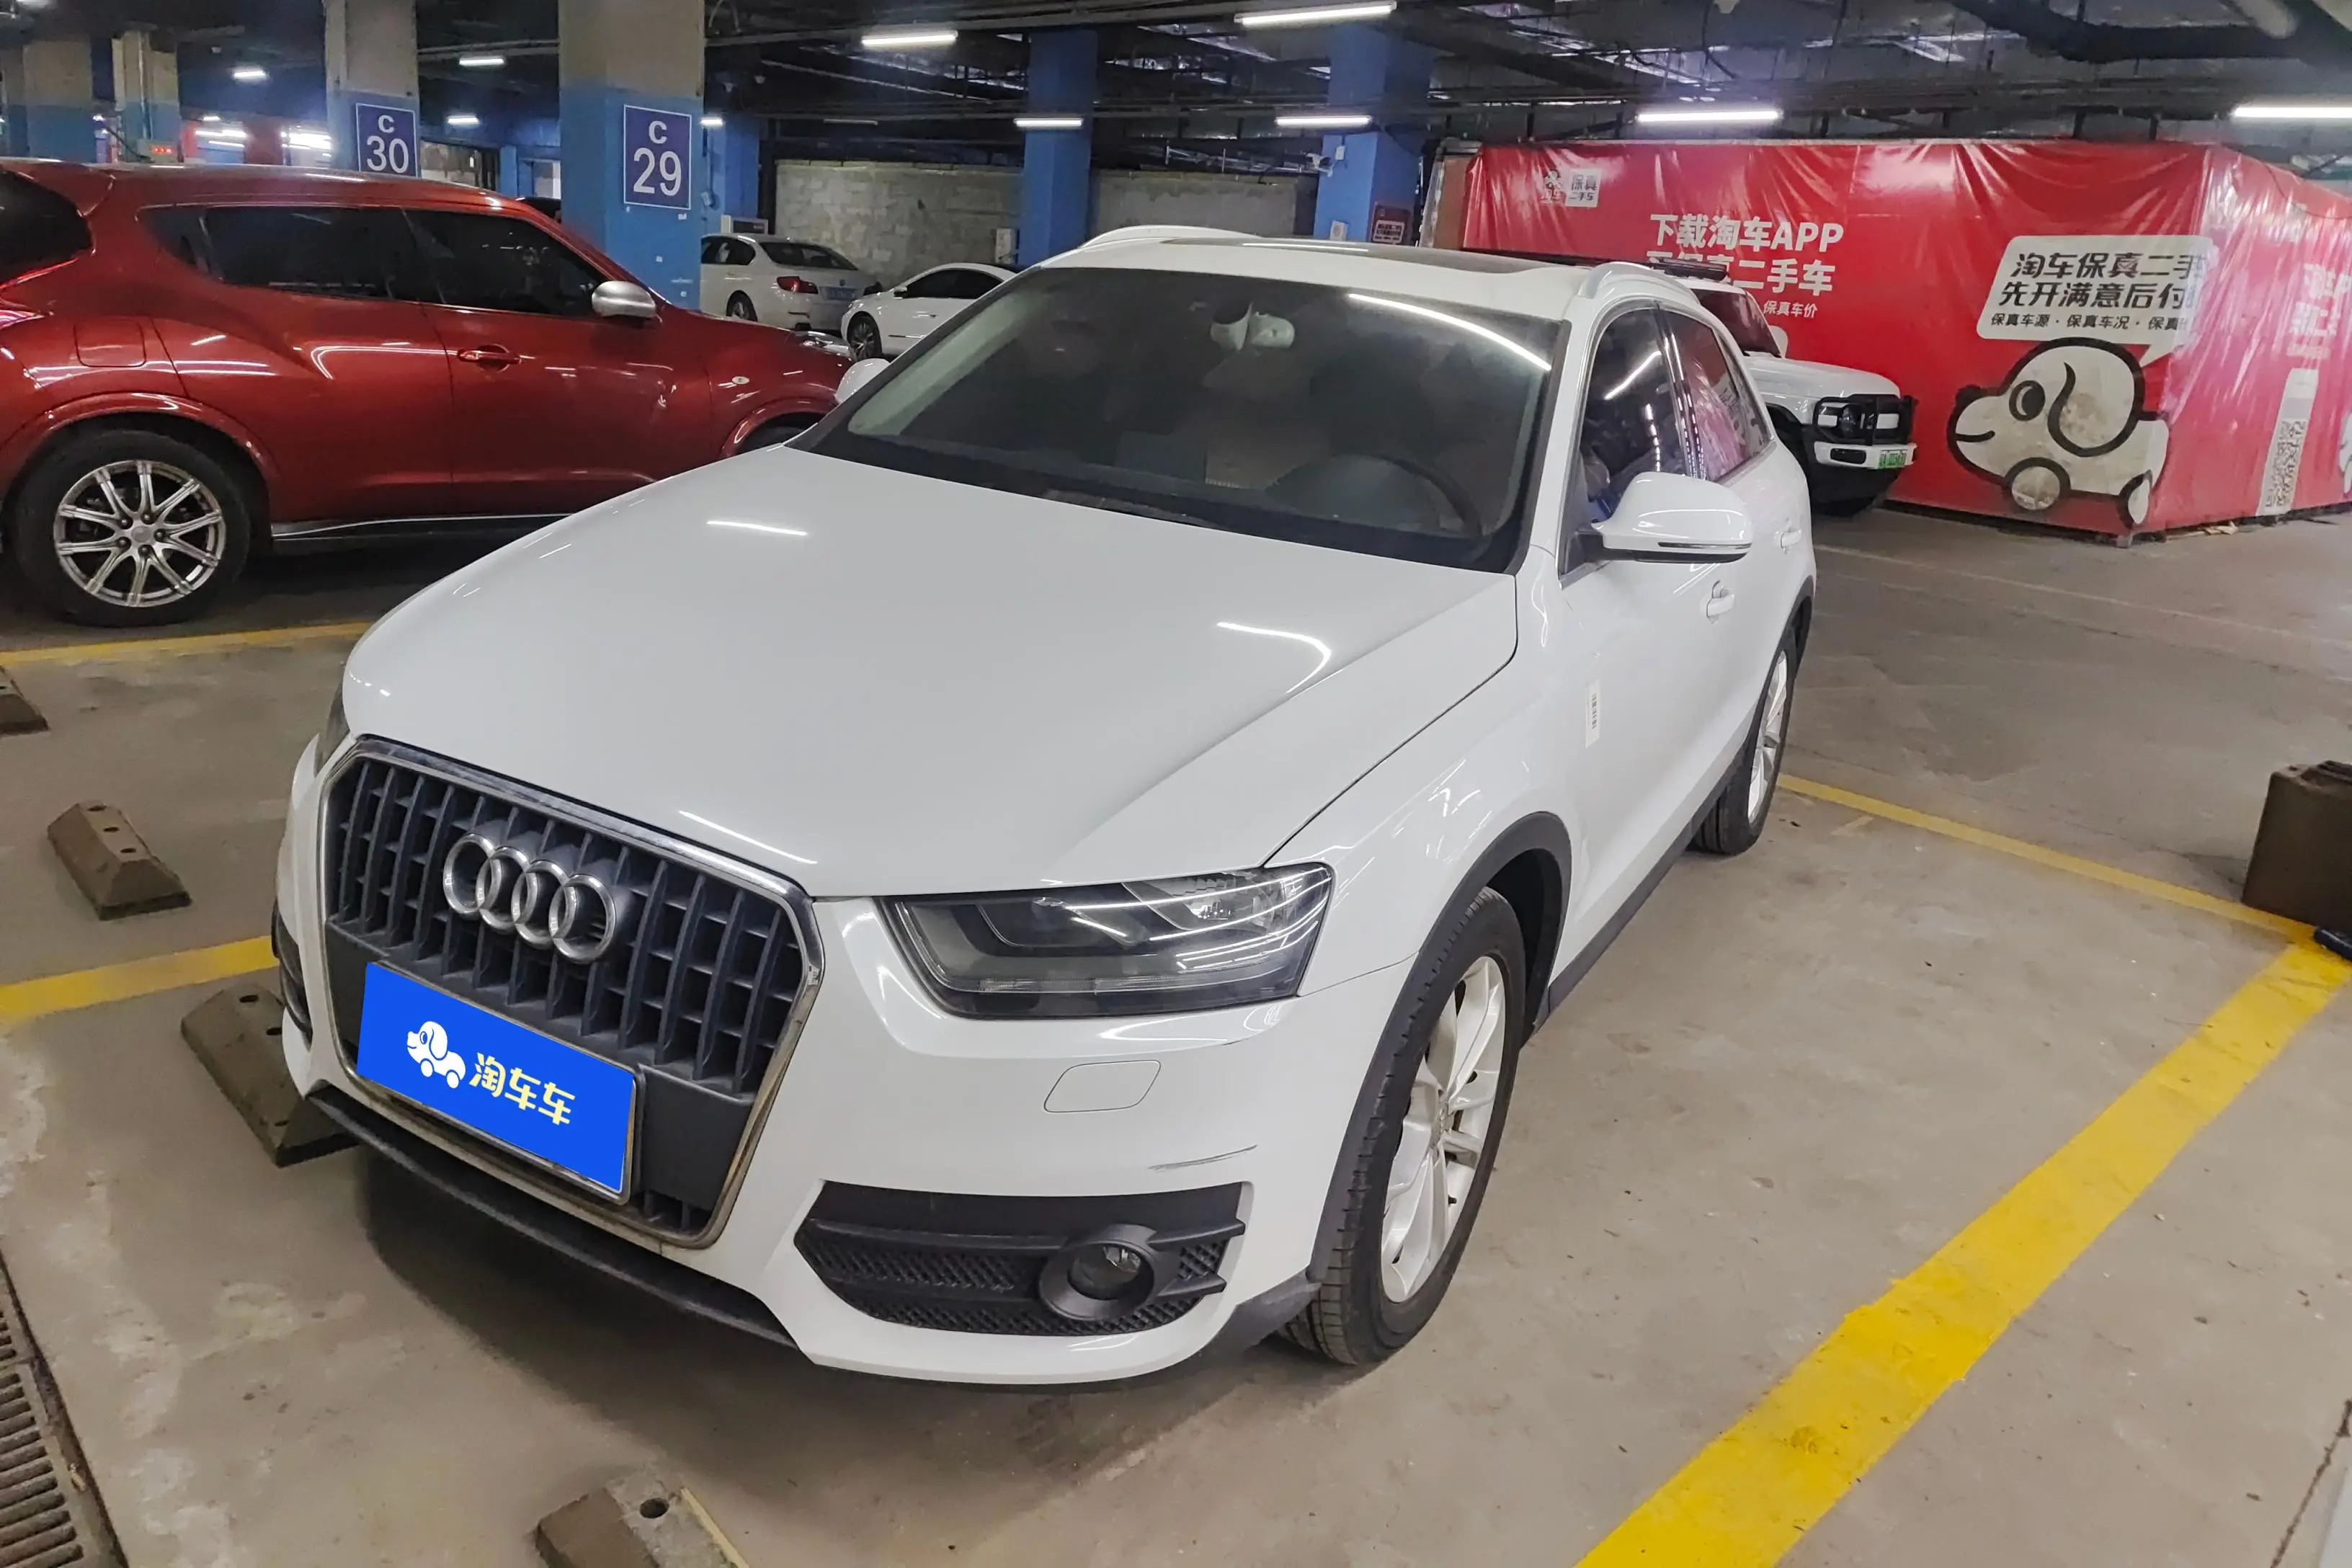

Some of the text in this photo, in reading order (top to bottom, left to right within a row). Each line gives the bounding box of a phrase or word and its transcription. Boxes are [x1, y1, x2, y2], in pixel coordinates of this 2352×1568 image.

[378, 115, 395, 133] C
[649, 120, 667, 144] C
[366, 135, 409, 174] 30
[633, 147, 682, 196] 29
[1650, 213, 1845, 253] 下载淘车APP
[2010, 252, 2206, 280] 淘车保真二手
[1999, 281, 2196, 309] 先开满意后付
